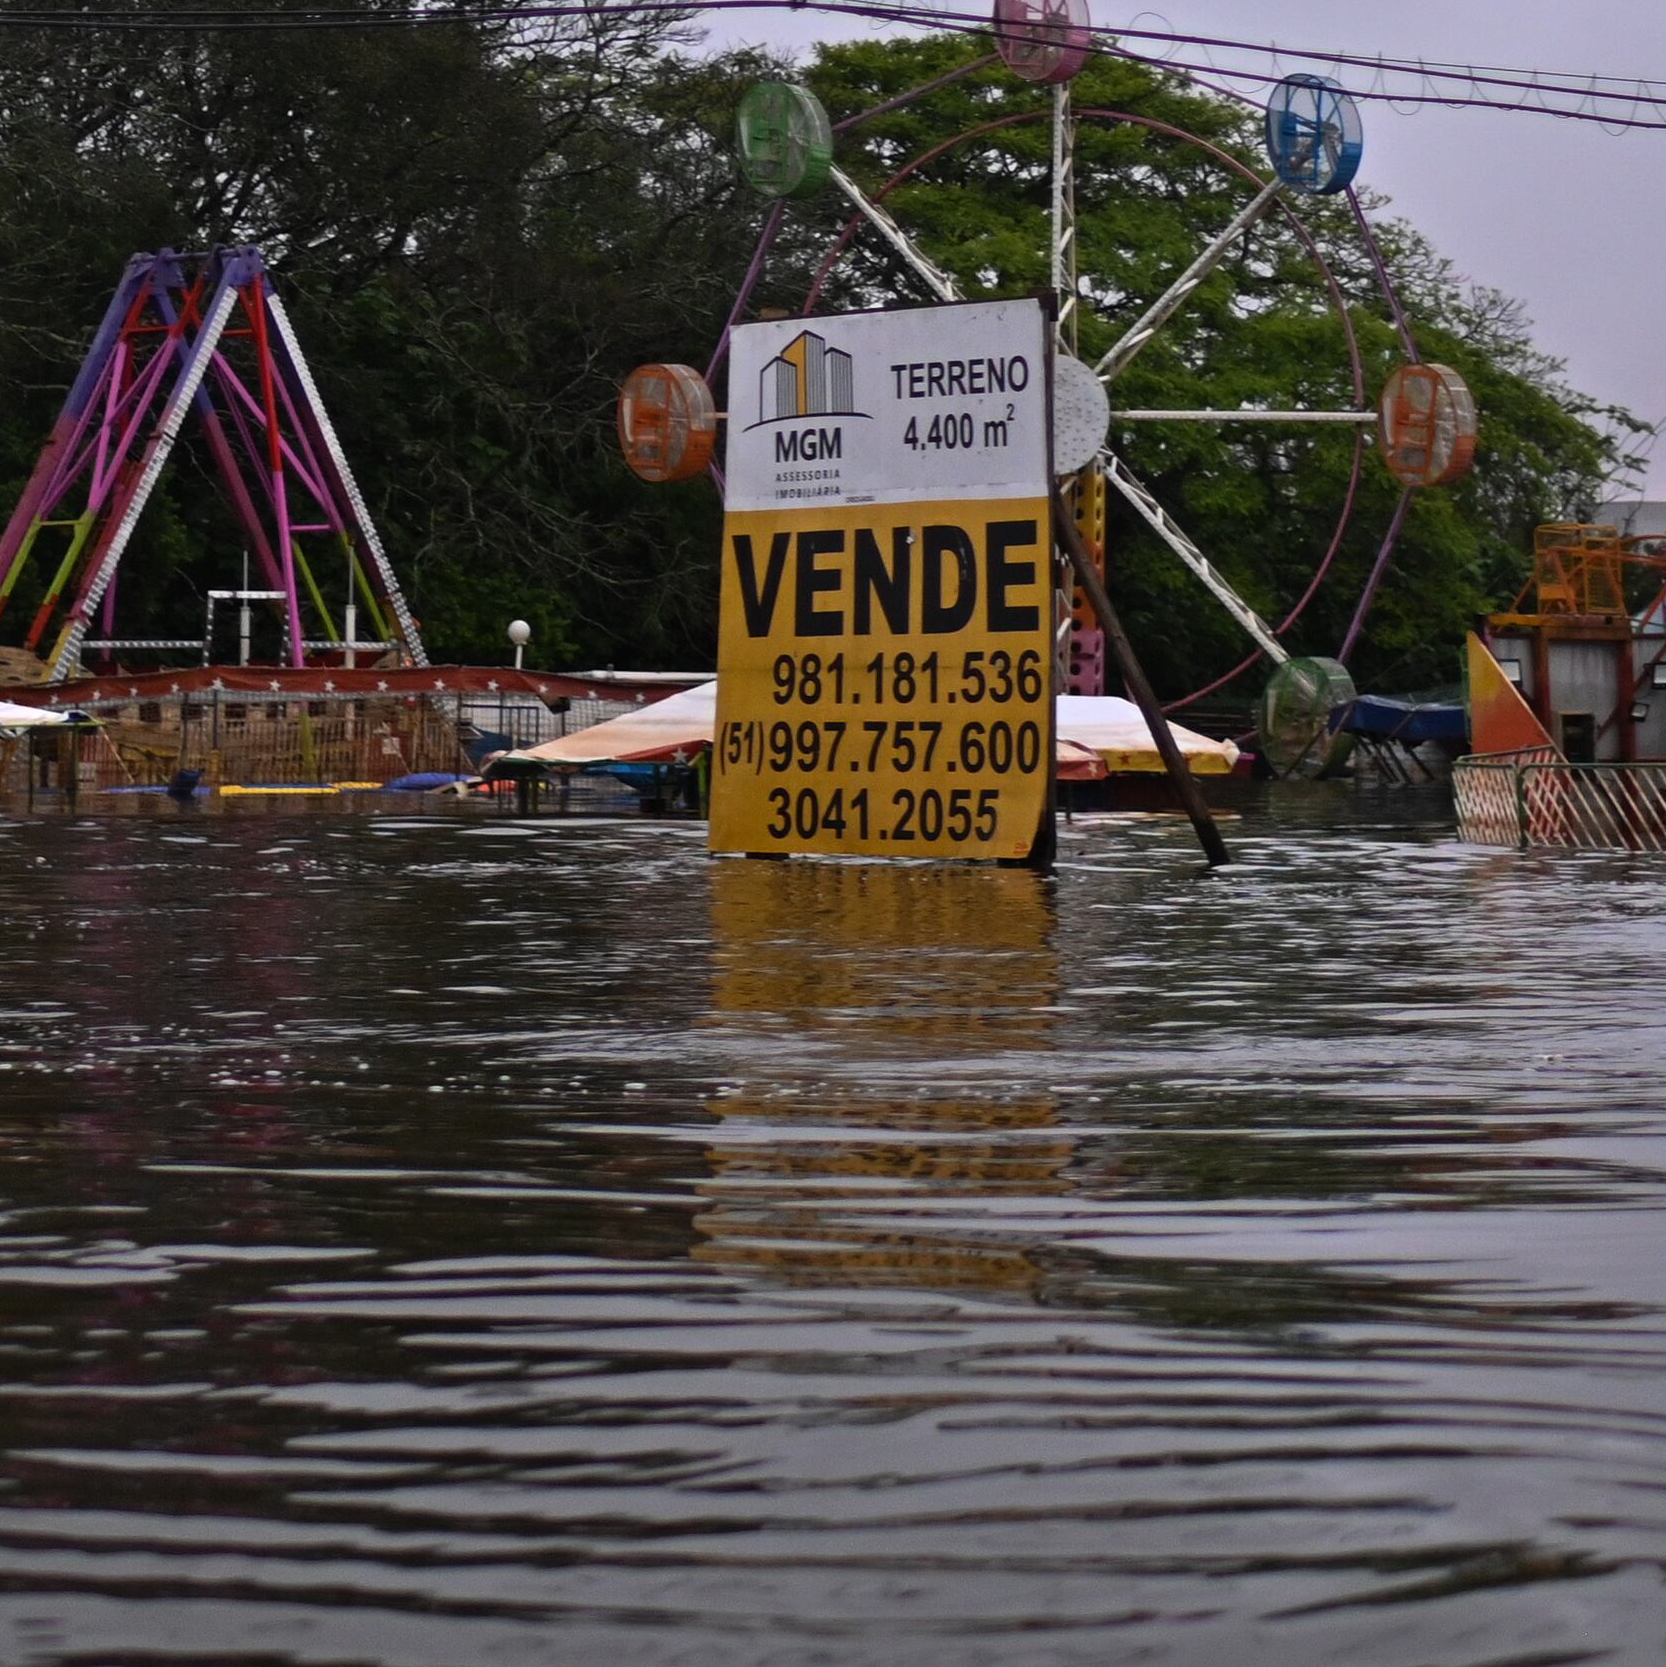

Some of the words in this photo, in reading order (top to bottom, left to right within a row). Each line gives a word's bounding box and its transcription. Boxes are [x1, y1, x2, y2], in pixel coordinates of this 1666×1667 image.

[890, 355, 1029, 399] TERRENO
[775, 426, 842, 463] MGM
[903, 412, 974, 451] 4.400
[775, 468, 841, 482] ASSESSORIA
[732, 519, 1040, 638] VENDE
[773, 649, 1043, 705] 981.181.536
[768, 787, 1001, 842] 3041.2055
